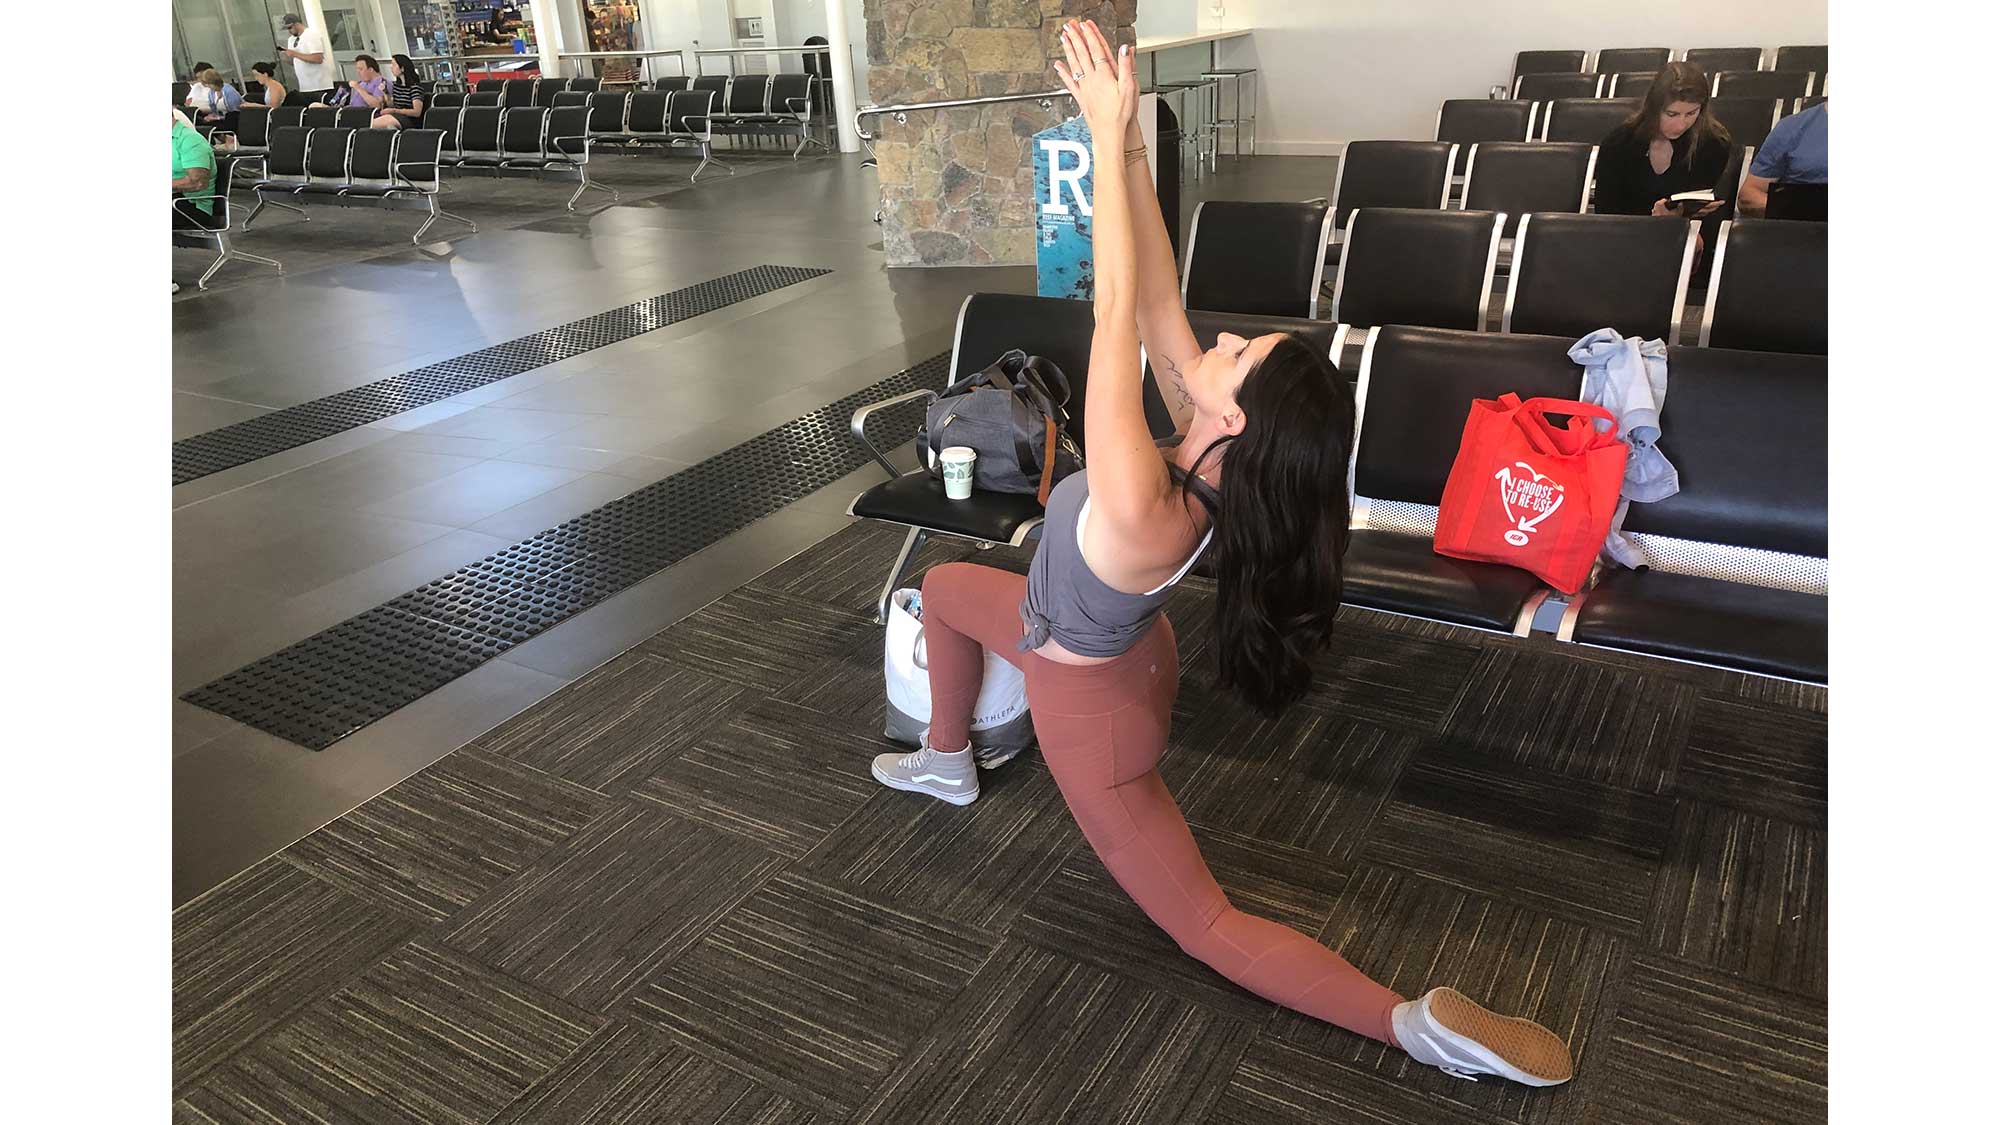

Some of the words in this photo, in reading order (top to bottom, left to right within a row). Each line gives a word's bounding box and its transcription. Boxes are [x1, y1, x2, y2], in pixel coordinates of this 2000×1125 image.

[1040, 140, 1093, 216] R
[1510, 477, 1517, 491] I
[1516, 479, 1554, 500] CHOOSE
[1506, 489, 1518, 504] TO
[1518, 493, 1553, 513] RE-USE
[978, 705, 1016, 725] ATHLETA
